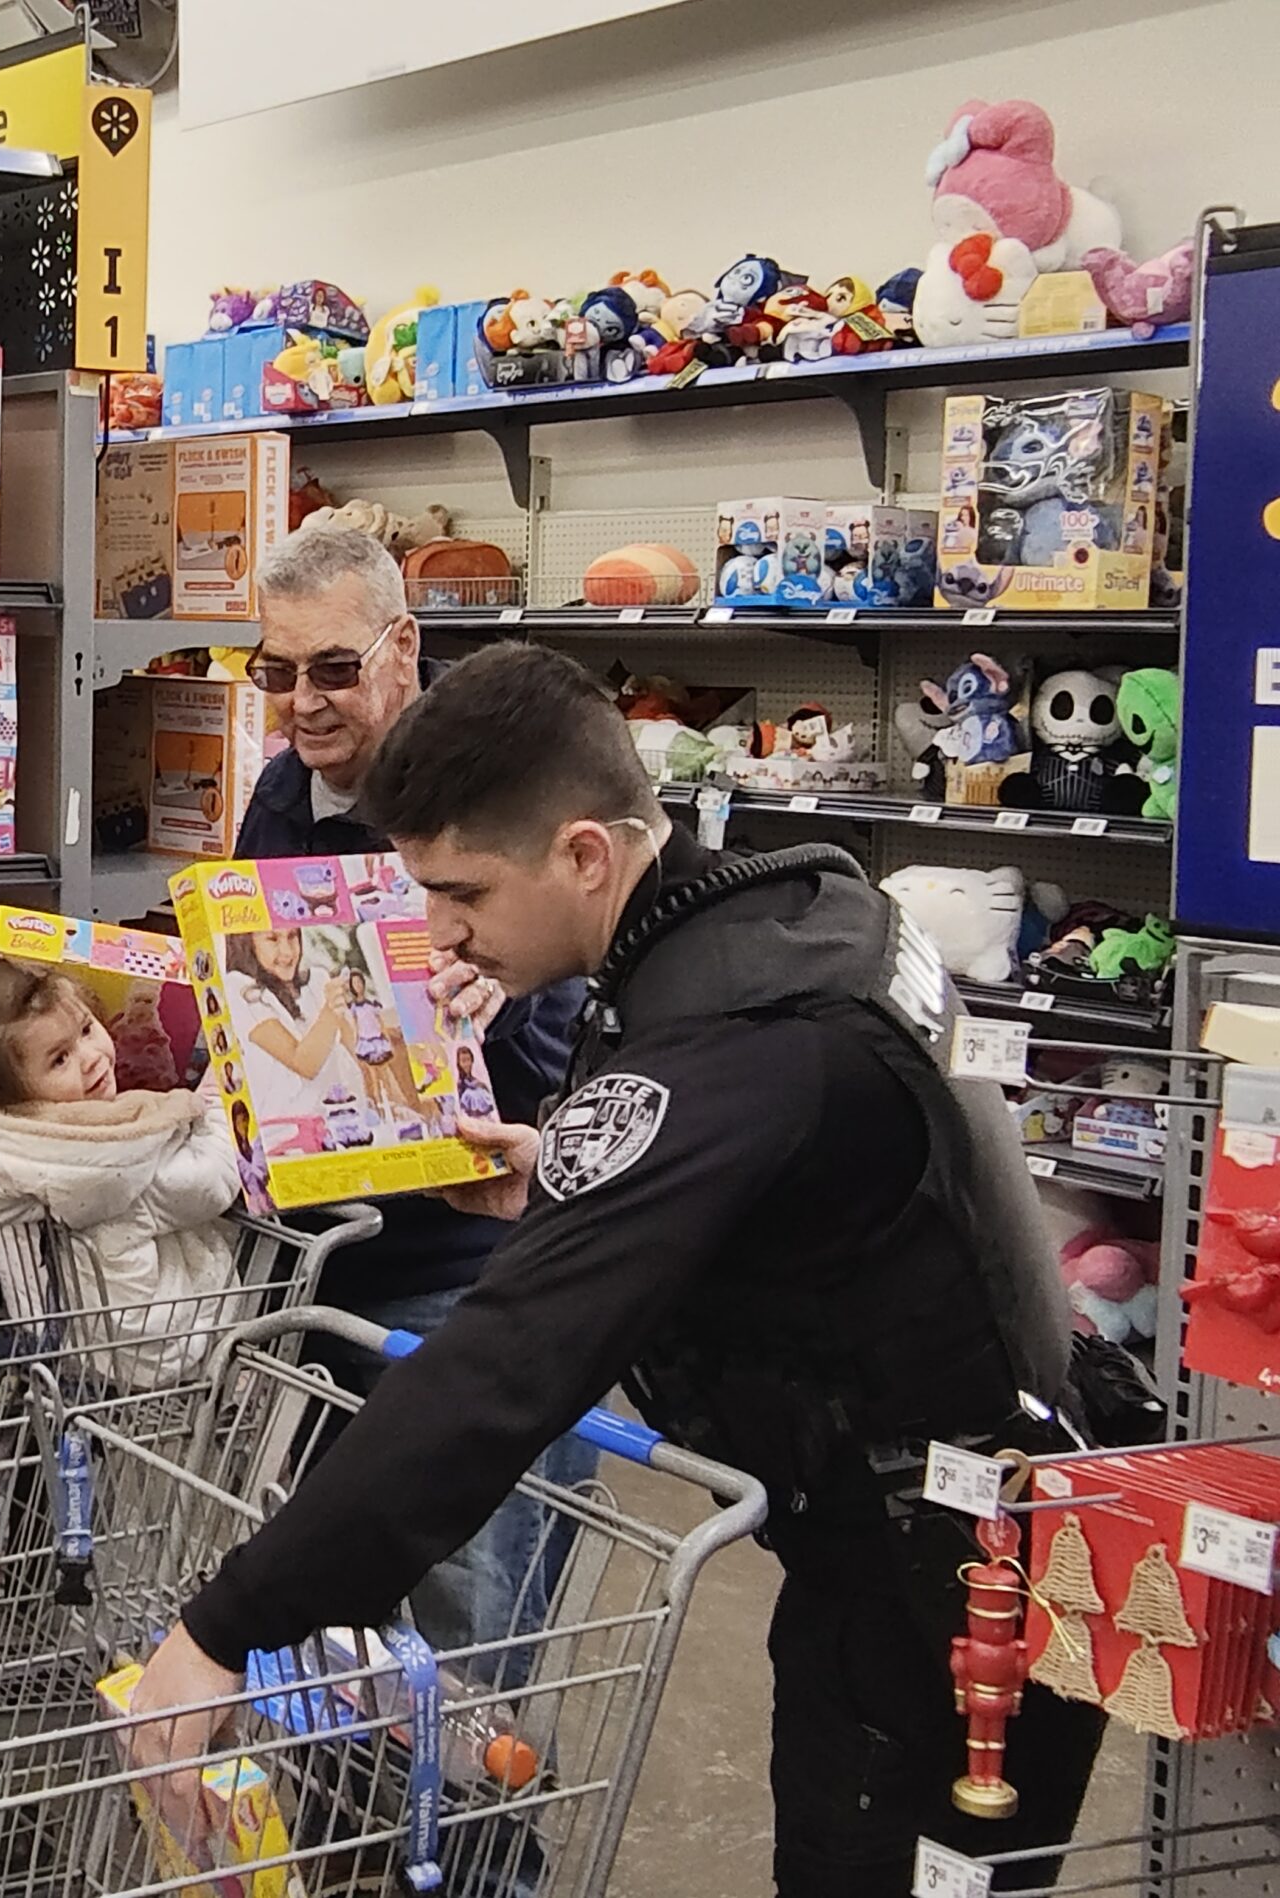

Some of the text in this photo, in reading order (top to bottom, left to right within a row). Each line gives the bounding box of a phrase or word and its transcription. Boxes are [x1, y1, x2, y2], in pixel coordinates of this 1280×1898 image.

[103, 248, 122, 295] I
[105, 315, 119, 358] 1
[1060, 511, 1098, 528] 100+
[1015, 571, 1086, 592] Ultimate
